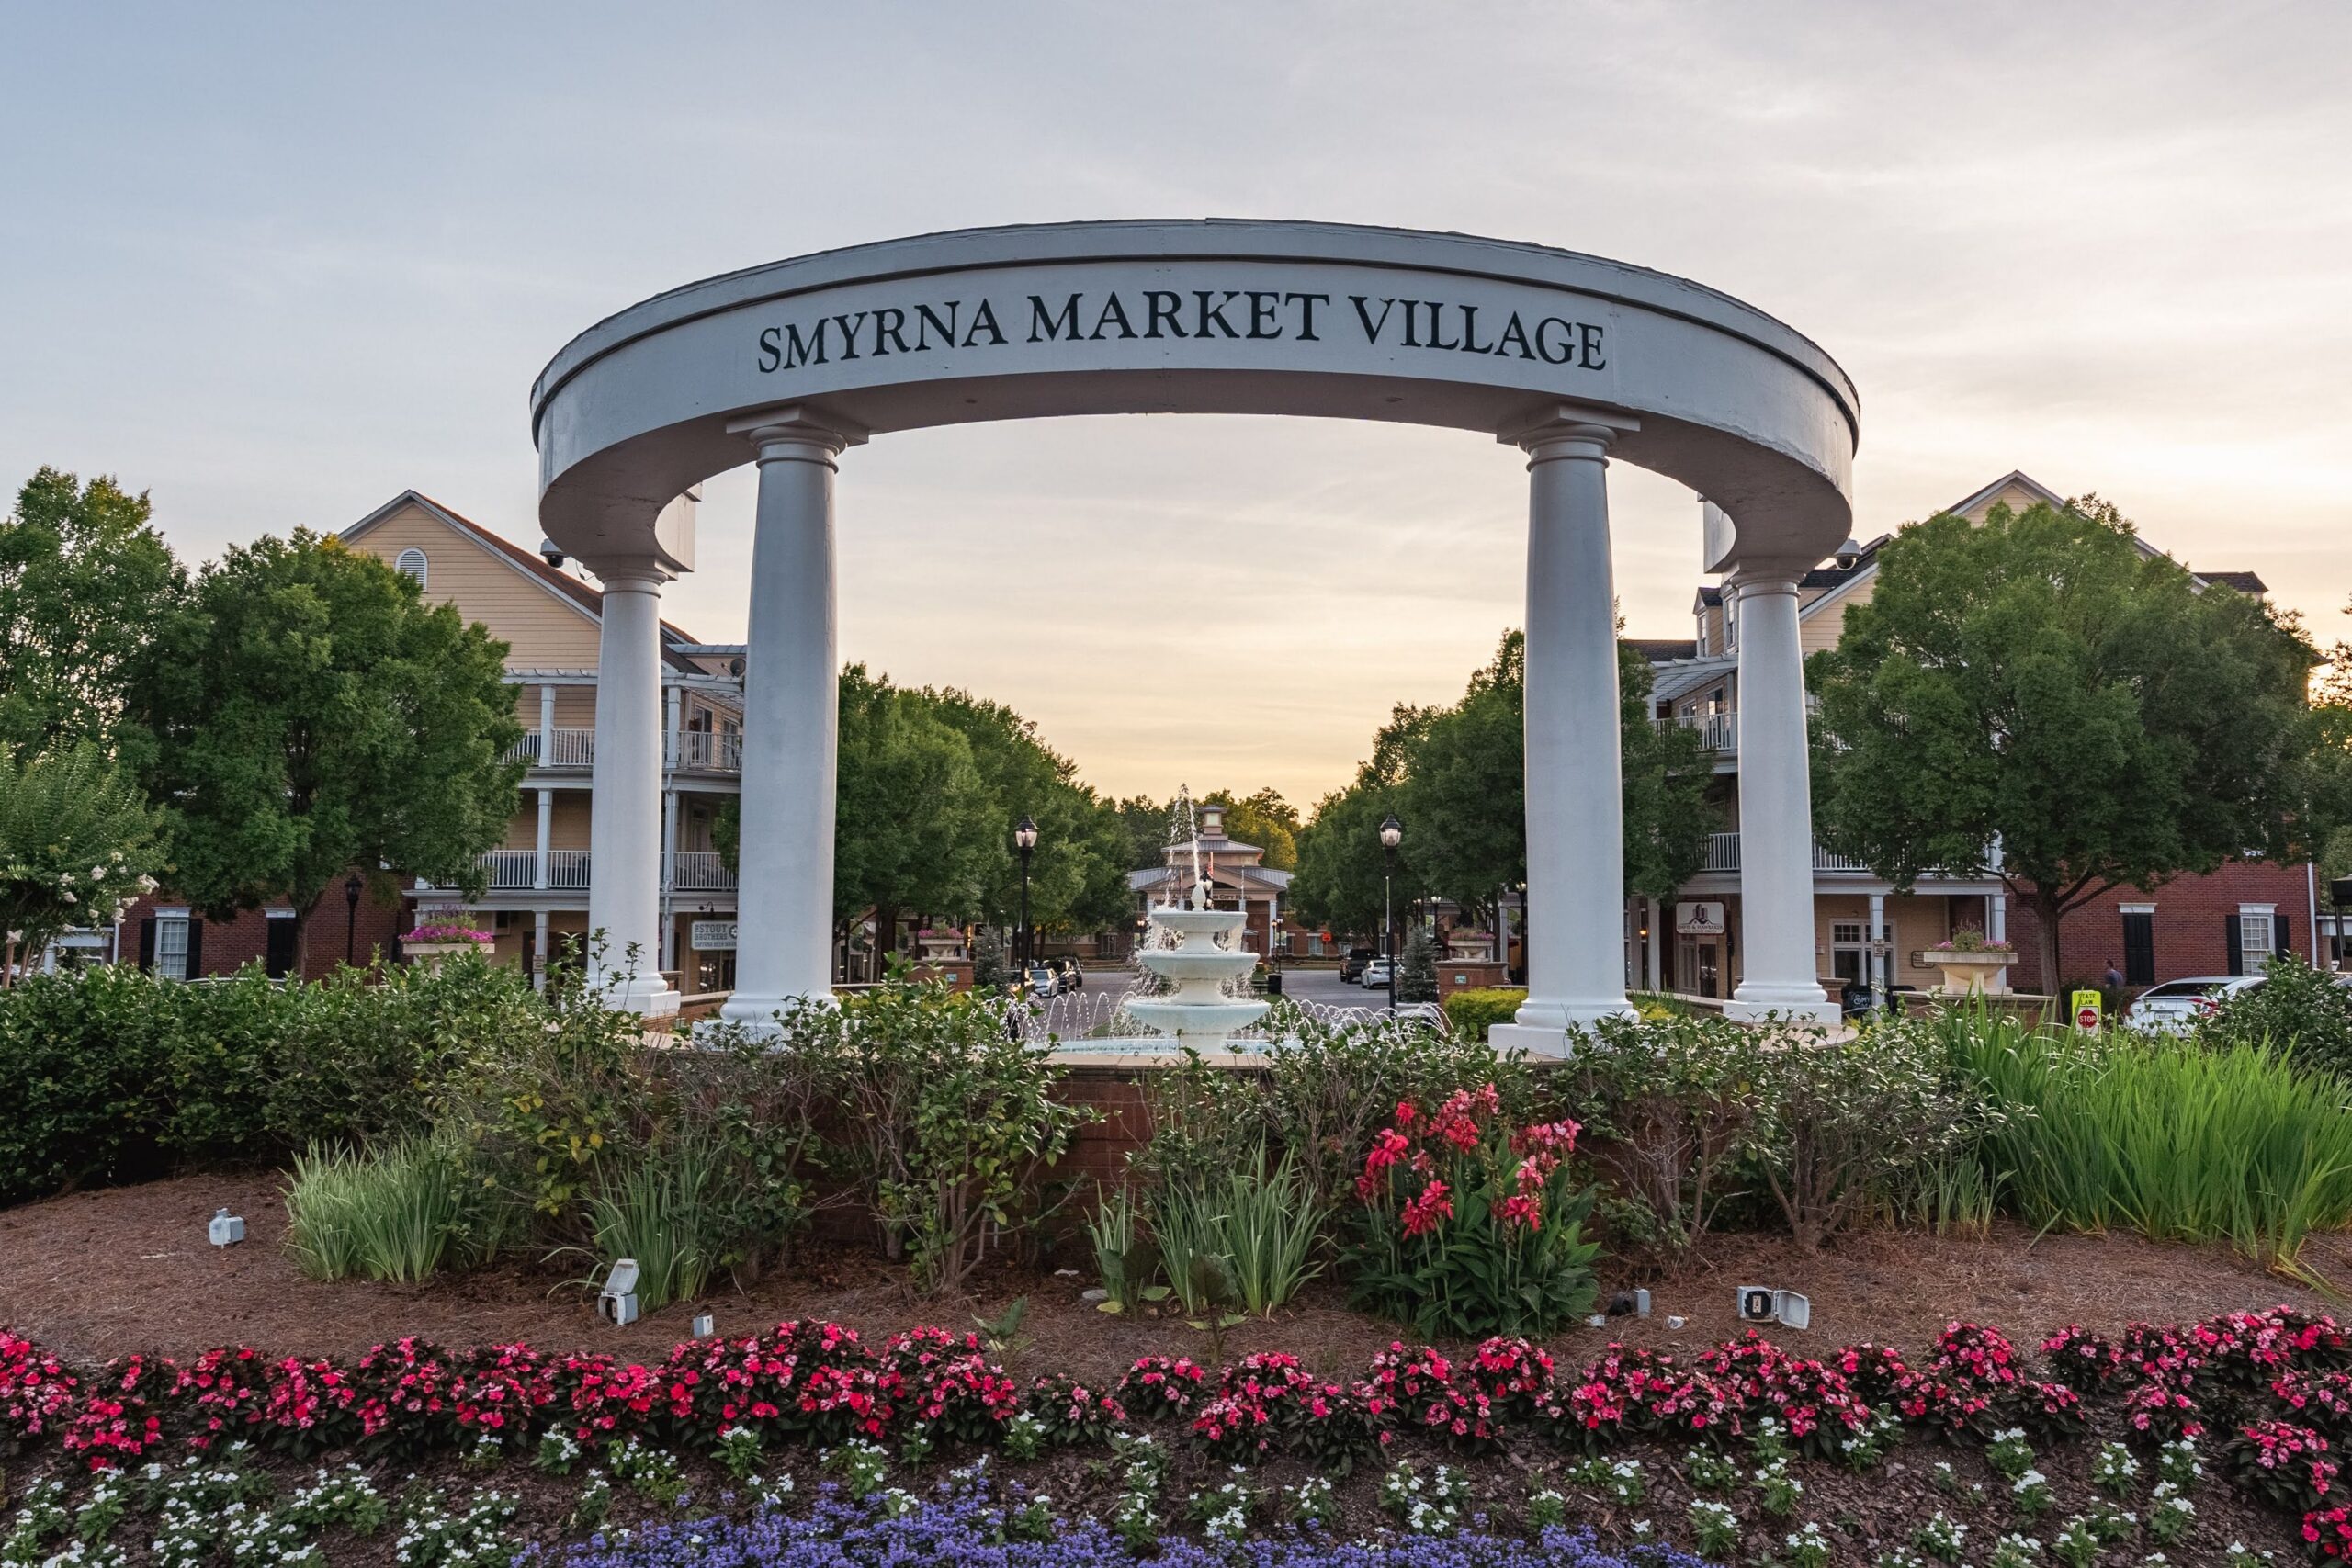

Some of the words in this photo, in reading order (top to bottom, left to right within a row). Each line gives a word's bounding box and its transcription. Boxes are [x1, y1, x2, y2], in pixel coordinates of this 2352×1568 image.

[757, 299, 1009, 374] SMYRNA
[1026, 290, 1330, 344] MARKET
[1347, 295, 1607, 371] VILLAGE
[2079, 1015, 2096, 1023] STOP
